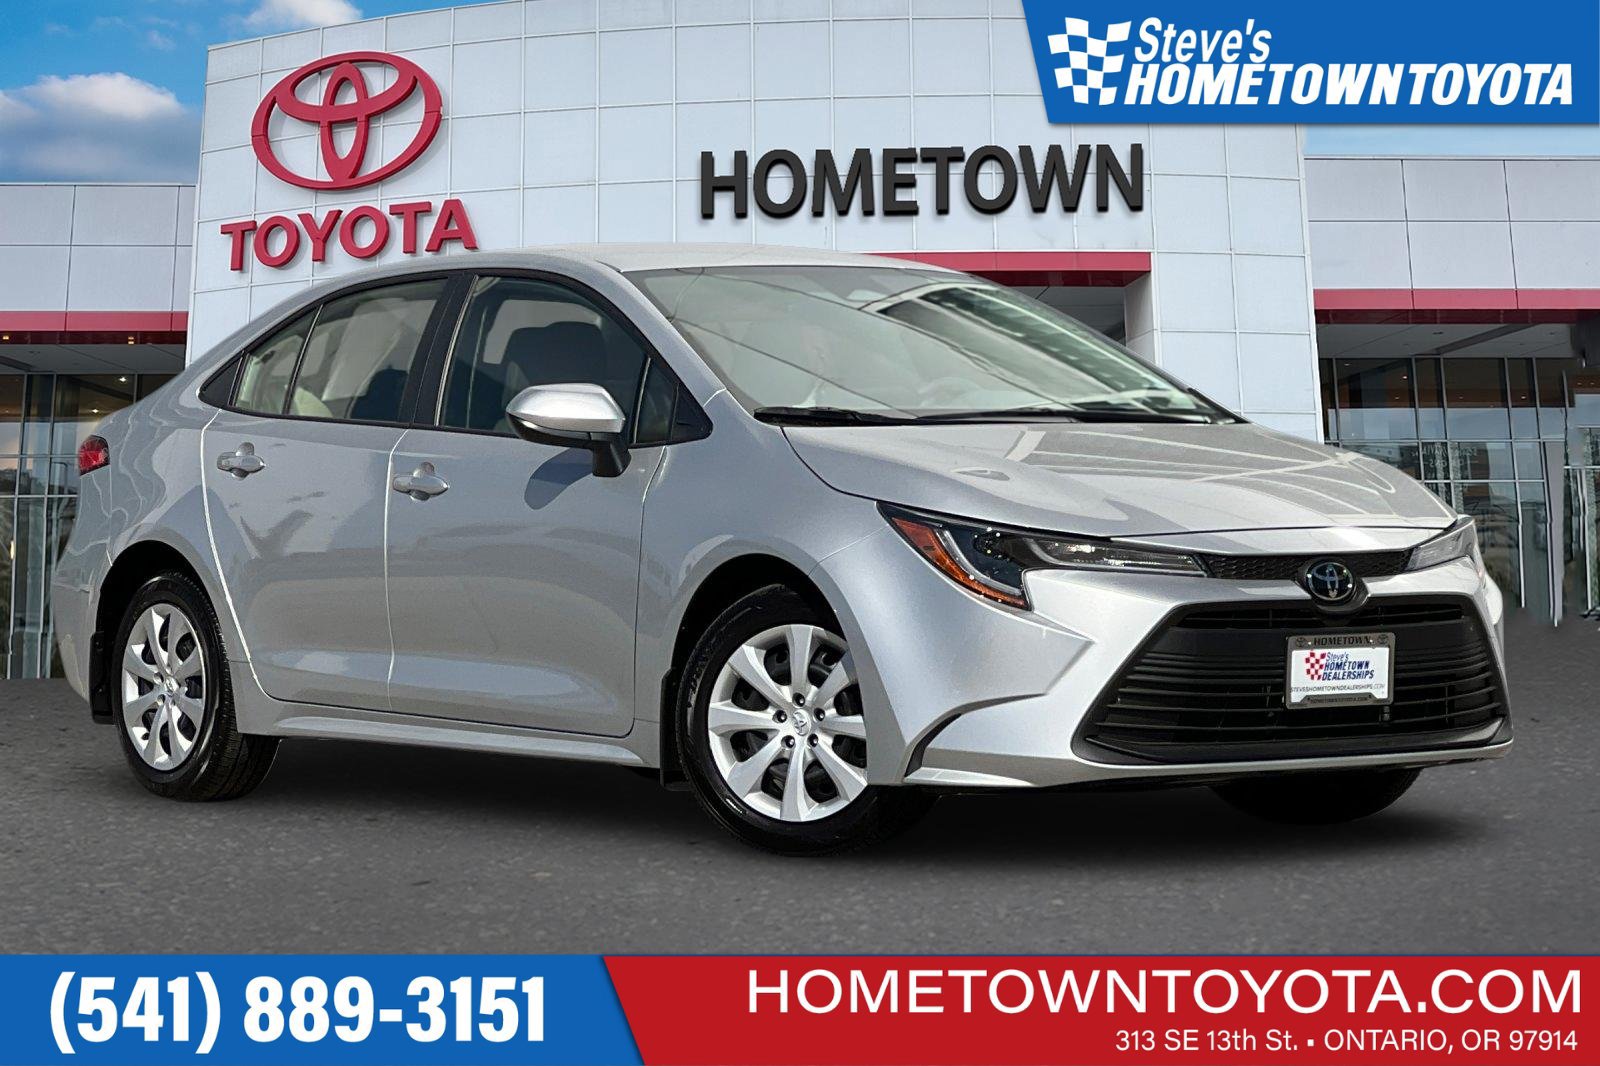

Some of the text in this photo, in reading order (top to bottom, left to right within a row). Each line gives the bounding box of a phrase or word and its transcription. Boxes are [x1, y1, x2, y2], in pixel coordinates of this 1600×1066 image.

[700, 144, 1144, 219] HOMETOWN
[220, 199, 478, 271] TOYOTA
[1314, 635, 1371, 646] HOMETOWN
[1326, 651, 1349, 662] Steve's
[1324, 660, 1370, 671] HOMETOWN
[1322, 670, 1374, 681] DEALERSHIPS
